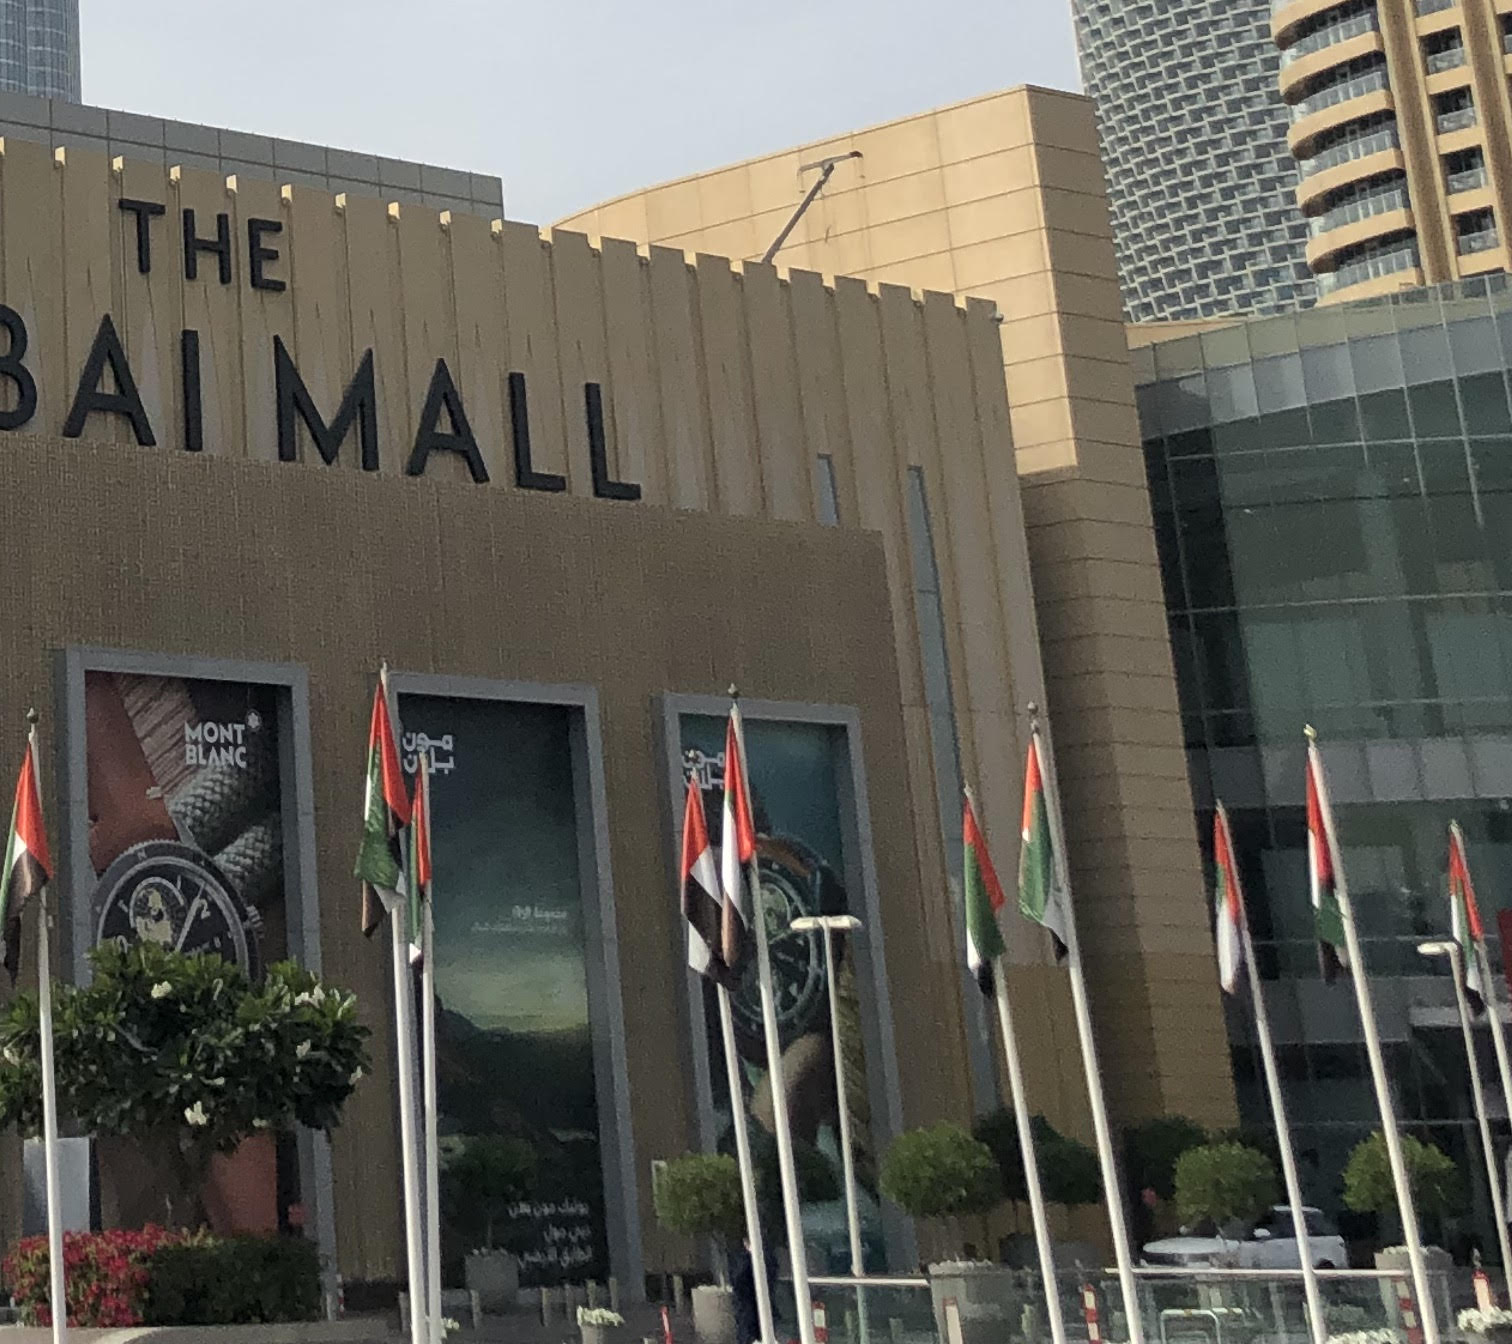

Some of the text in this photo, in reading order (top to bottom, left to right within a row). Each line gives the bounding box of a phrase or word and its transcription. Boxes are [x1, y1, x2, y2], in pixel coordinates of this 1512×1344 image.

[118, 198, 286, 292] THE
[273, 334, 641, 501] MALL
[184, 721, 246, 744] MONT
[185, 743, 247, 769] BLANC
